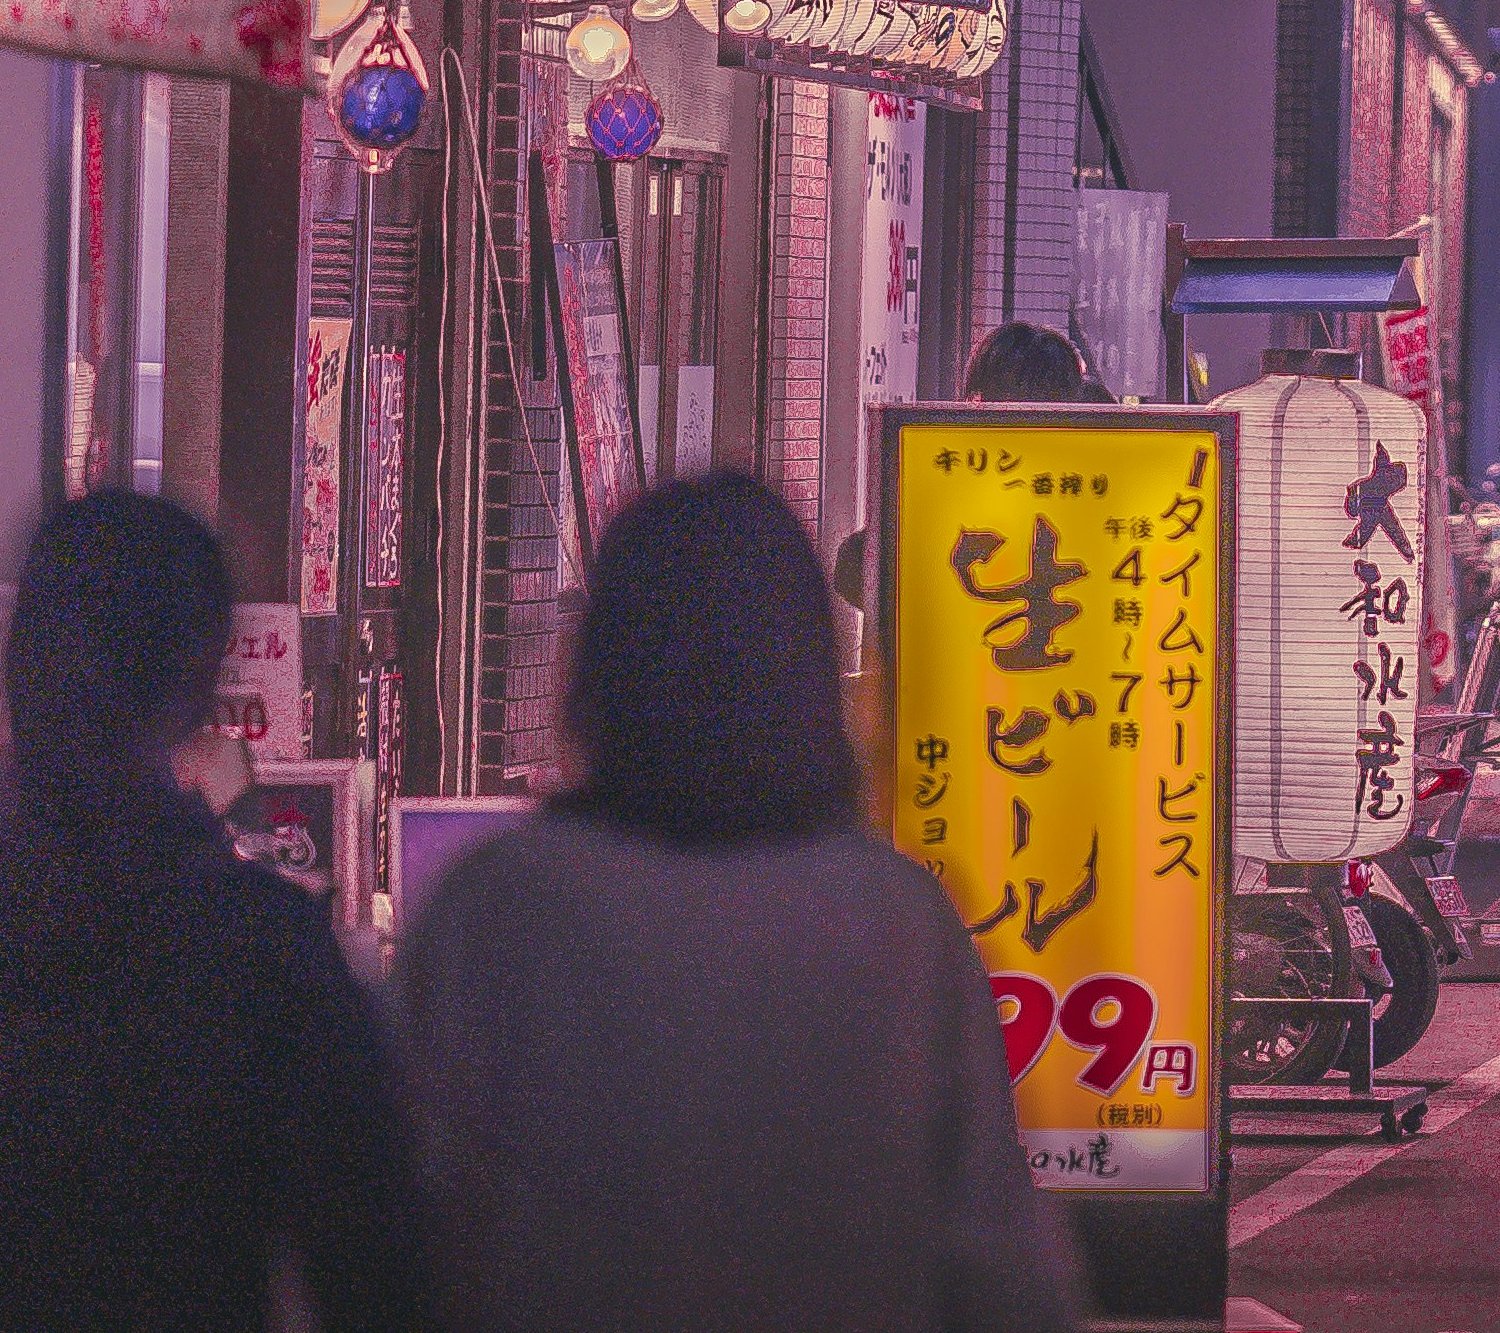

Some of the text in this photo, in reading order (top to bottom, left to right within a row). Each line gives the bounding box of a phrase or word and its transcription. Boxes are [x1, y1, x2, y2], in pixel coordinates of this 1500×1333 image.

[933, 445, 1023, 473] キリン
[950, 515, 1098, 954] 生ビール
[1096, 1103, 1163, 1127] (税別)
